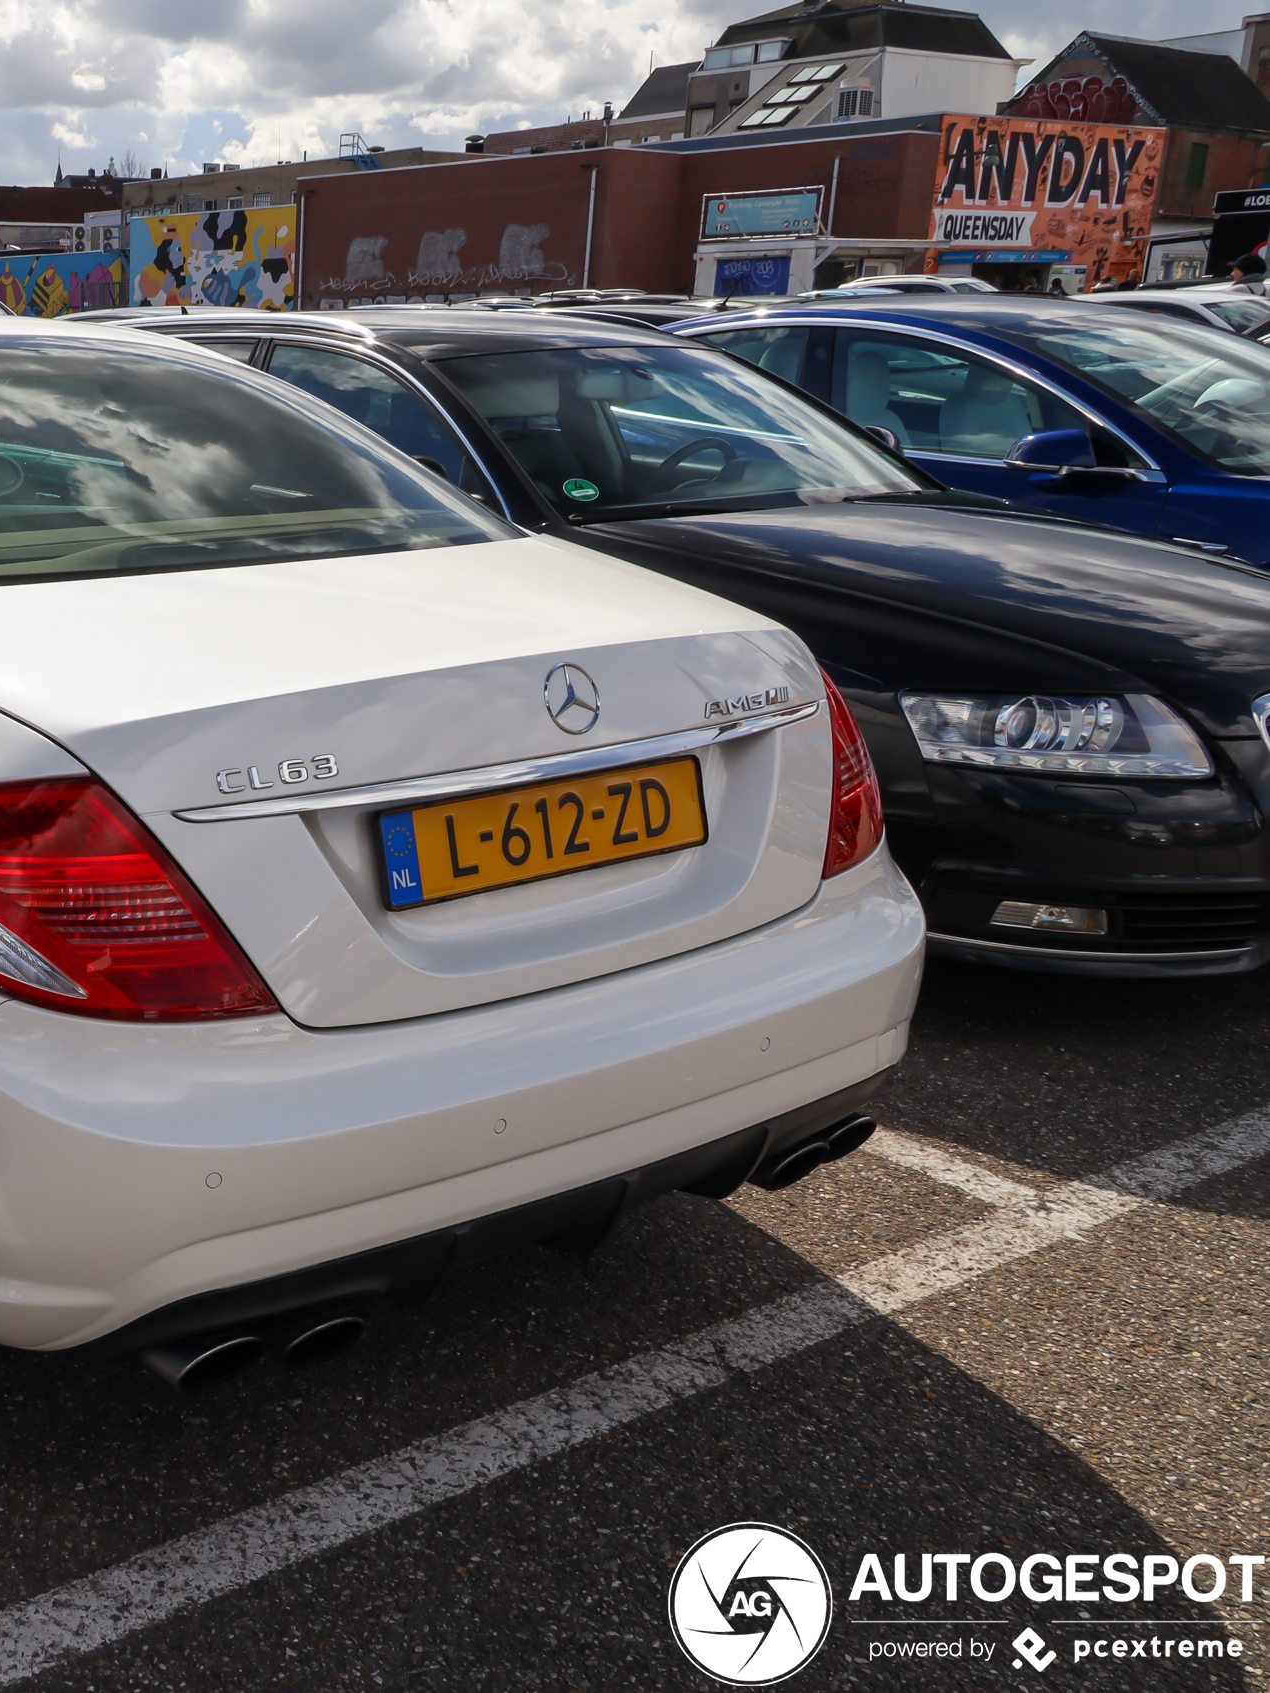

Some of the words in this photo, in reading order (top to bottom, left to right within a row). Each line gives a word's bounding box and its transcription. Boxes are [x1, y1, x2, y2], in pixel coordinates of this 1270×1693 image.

[935, 128, 1147, 208] ANYDAY
[943, 214, 1025, 241] QUEENSDAY
[574, 480, 585, 490] 4
[704, 692, 766, 719] AMG
[445, 778, 671, 878] L-612-ZD
[391, 868, 417, 890] NL
